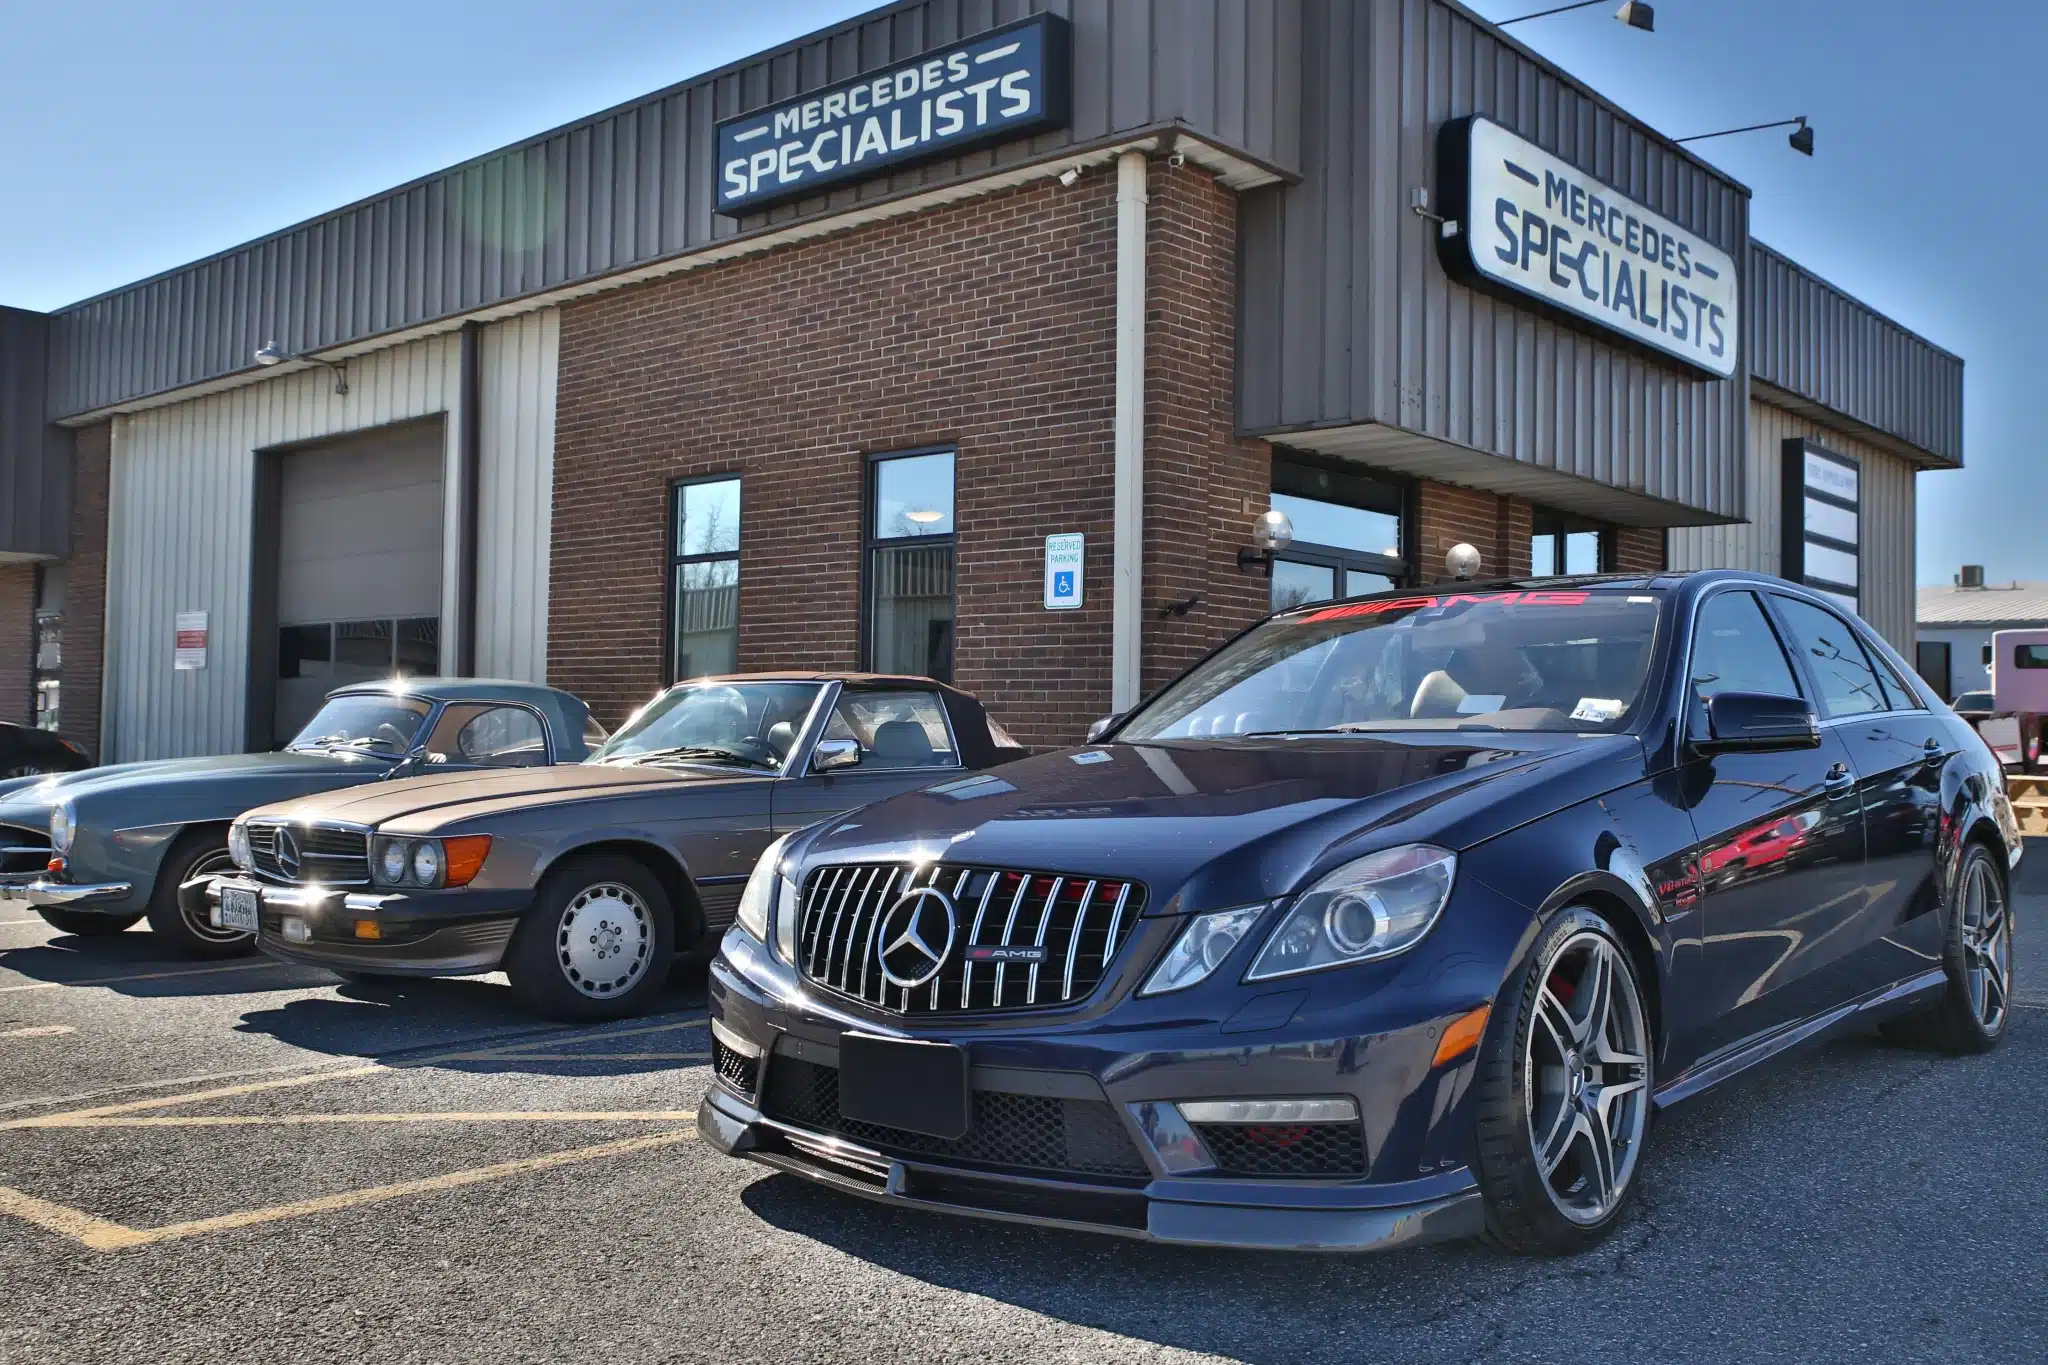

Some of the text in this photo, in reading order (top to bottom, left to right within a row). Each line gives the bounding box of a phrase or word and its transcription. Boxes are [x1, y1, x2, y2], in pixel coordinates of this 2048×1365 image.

[724, 69, 1031, 199] SPECIALISTS
[774, 51, 969, 139] MERCEDES
[1544, 169, 1691, 279] MERCEDES
[1494, 197, 1725, 358] SPECIALISTS
[1049, 541, 1080, 551] RESERVED
[1051, 553, 1079, 563] PARKING
[991, 950, 1042, 958] AMG
